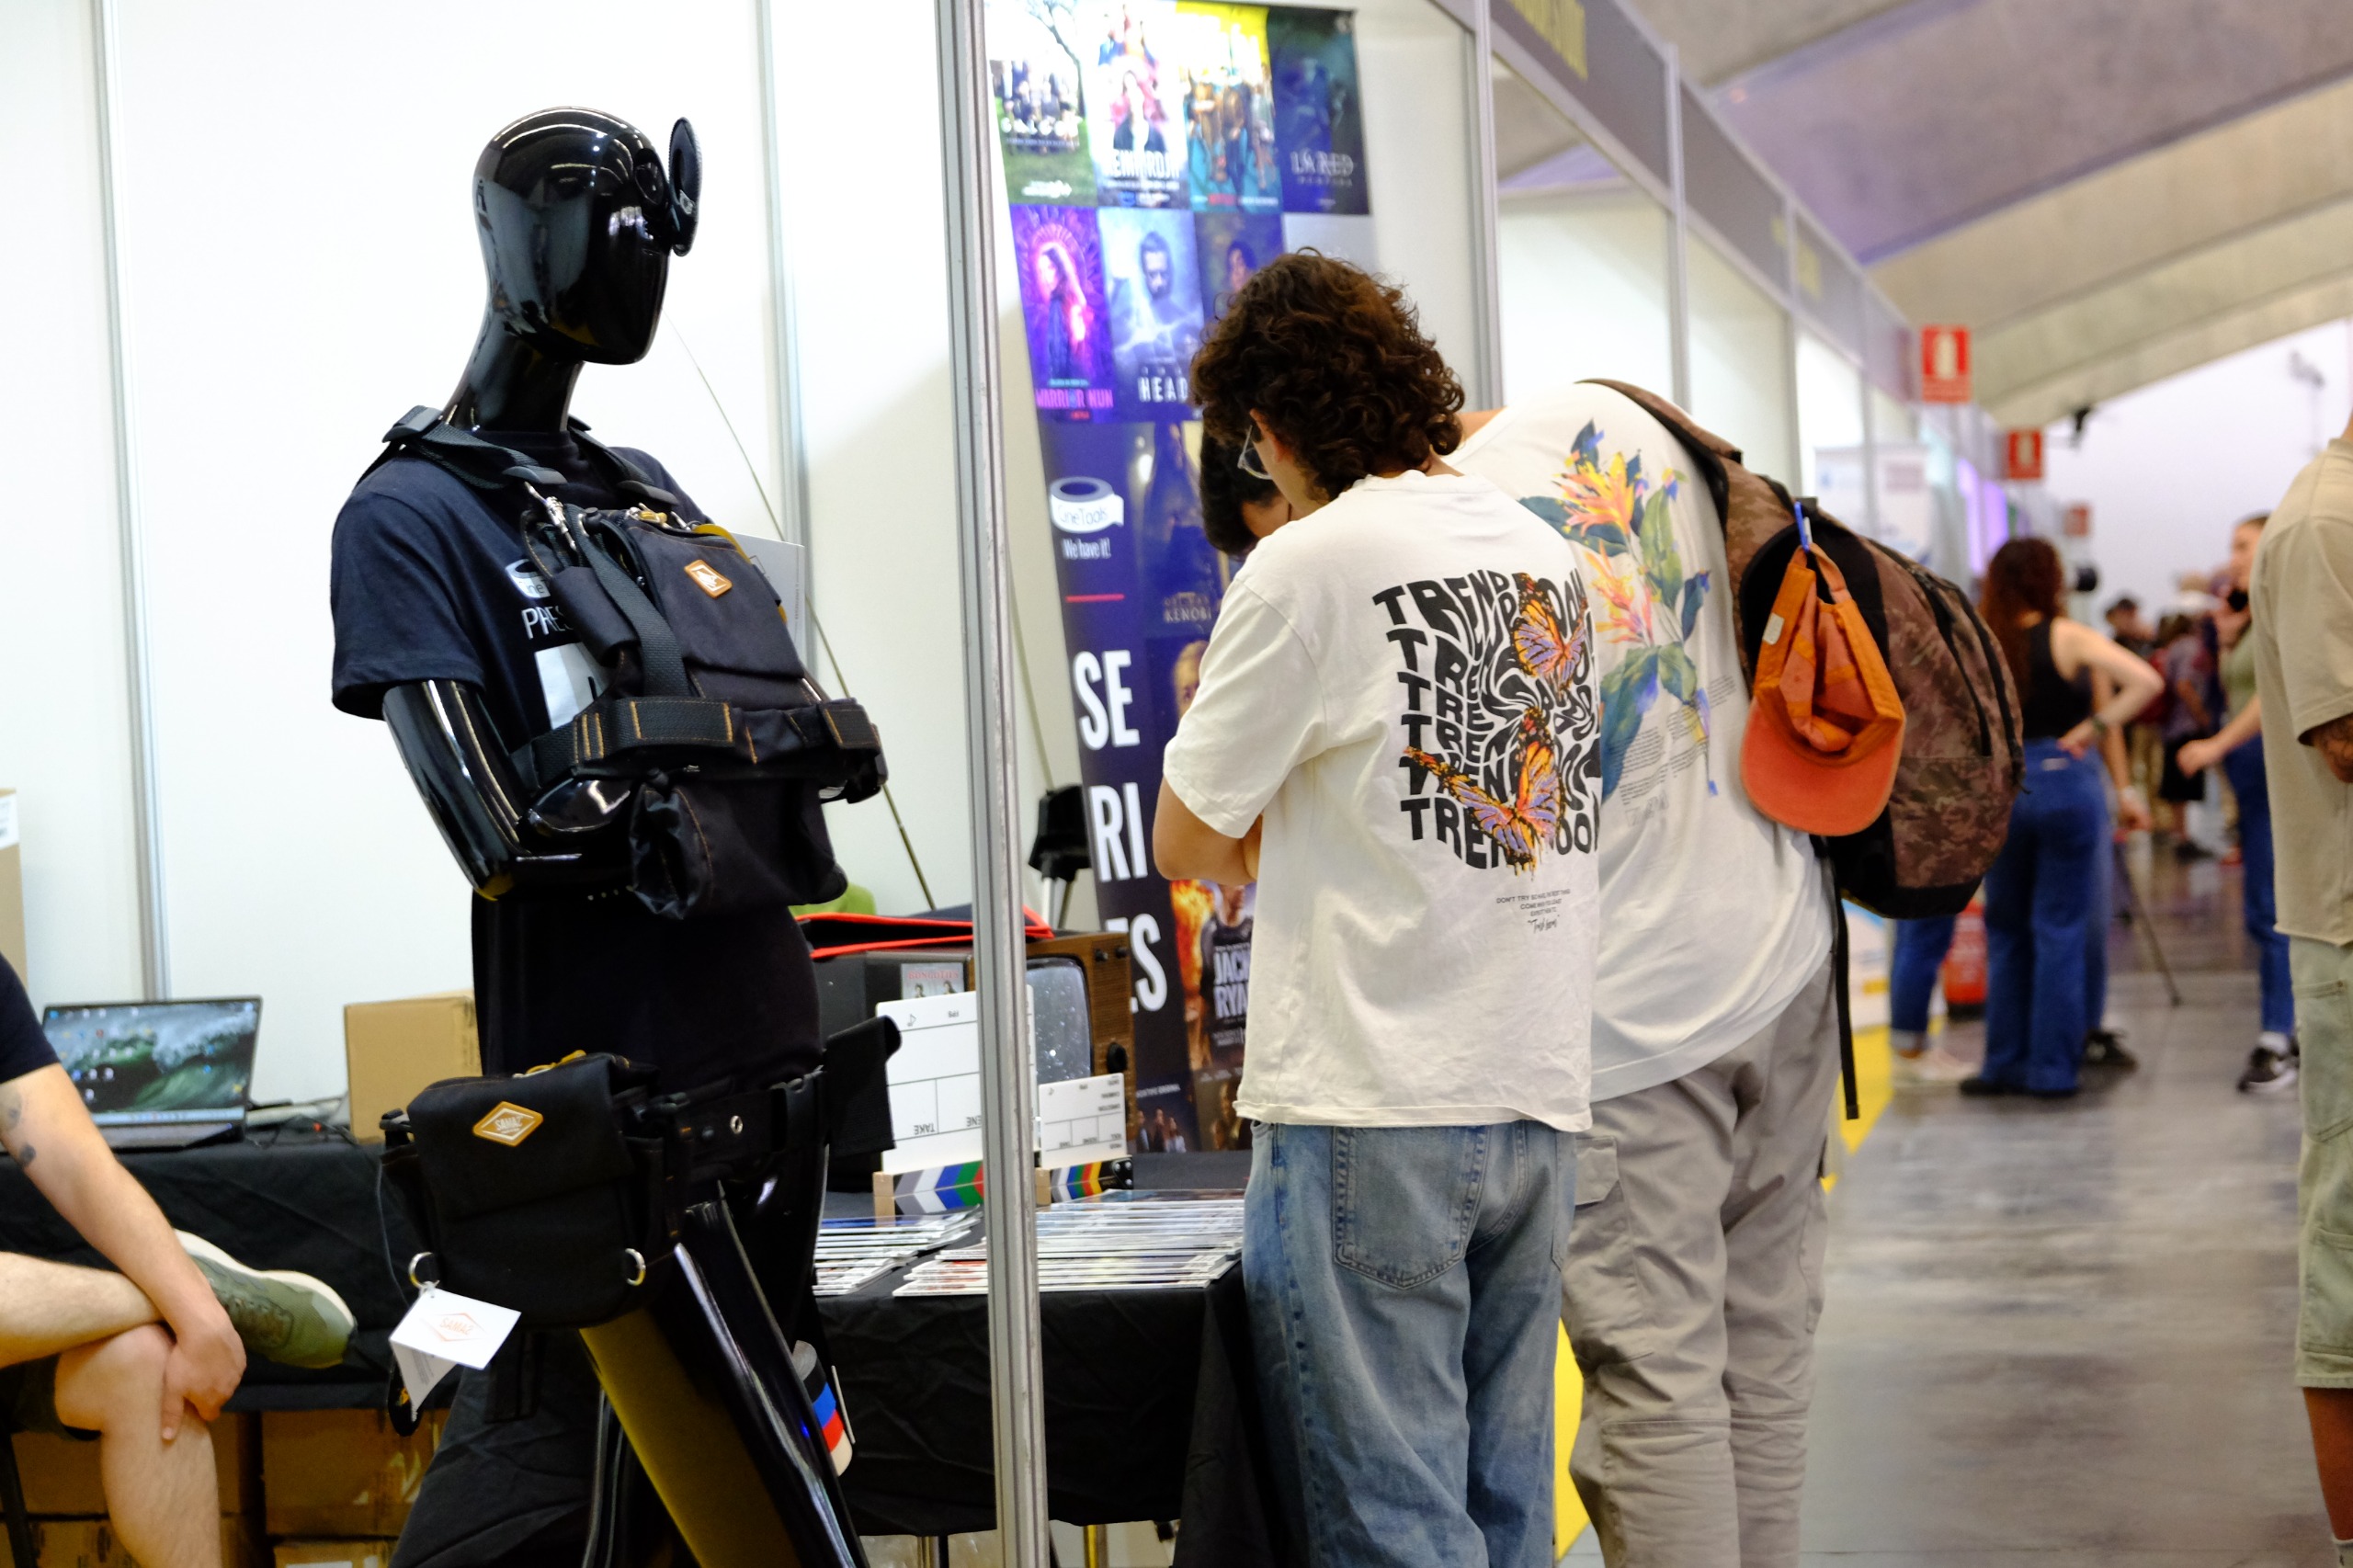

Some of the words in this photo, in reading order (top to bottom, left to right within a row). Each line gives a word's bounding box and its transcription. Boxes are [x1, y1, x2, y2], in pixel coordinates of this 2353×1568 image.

[1087, 389, 1113, 409] NUN
[1138, 376, 1188, 403] HEAD
[1063, 538, 1078, 560] We
[1077, 538, 1100, 560] have
[1165, 608, 1211, 623] KENOBI
[1074, 650, 1141, 751] SE
[1088, 781, 1149, 882] RI
[1213, 983, 1249, 1019] RYA
[914, 1122, 936, 1136] TAKE
[966, 1115, 983, 1127] ENE
